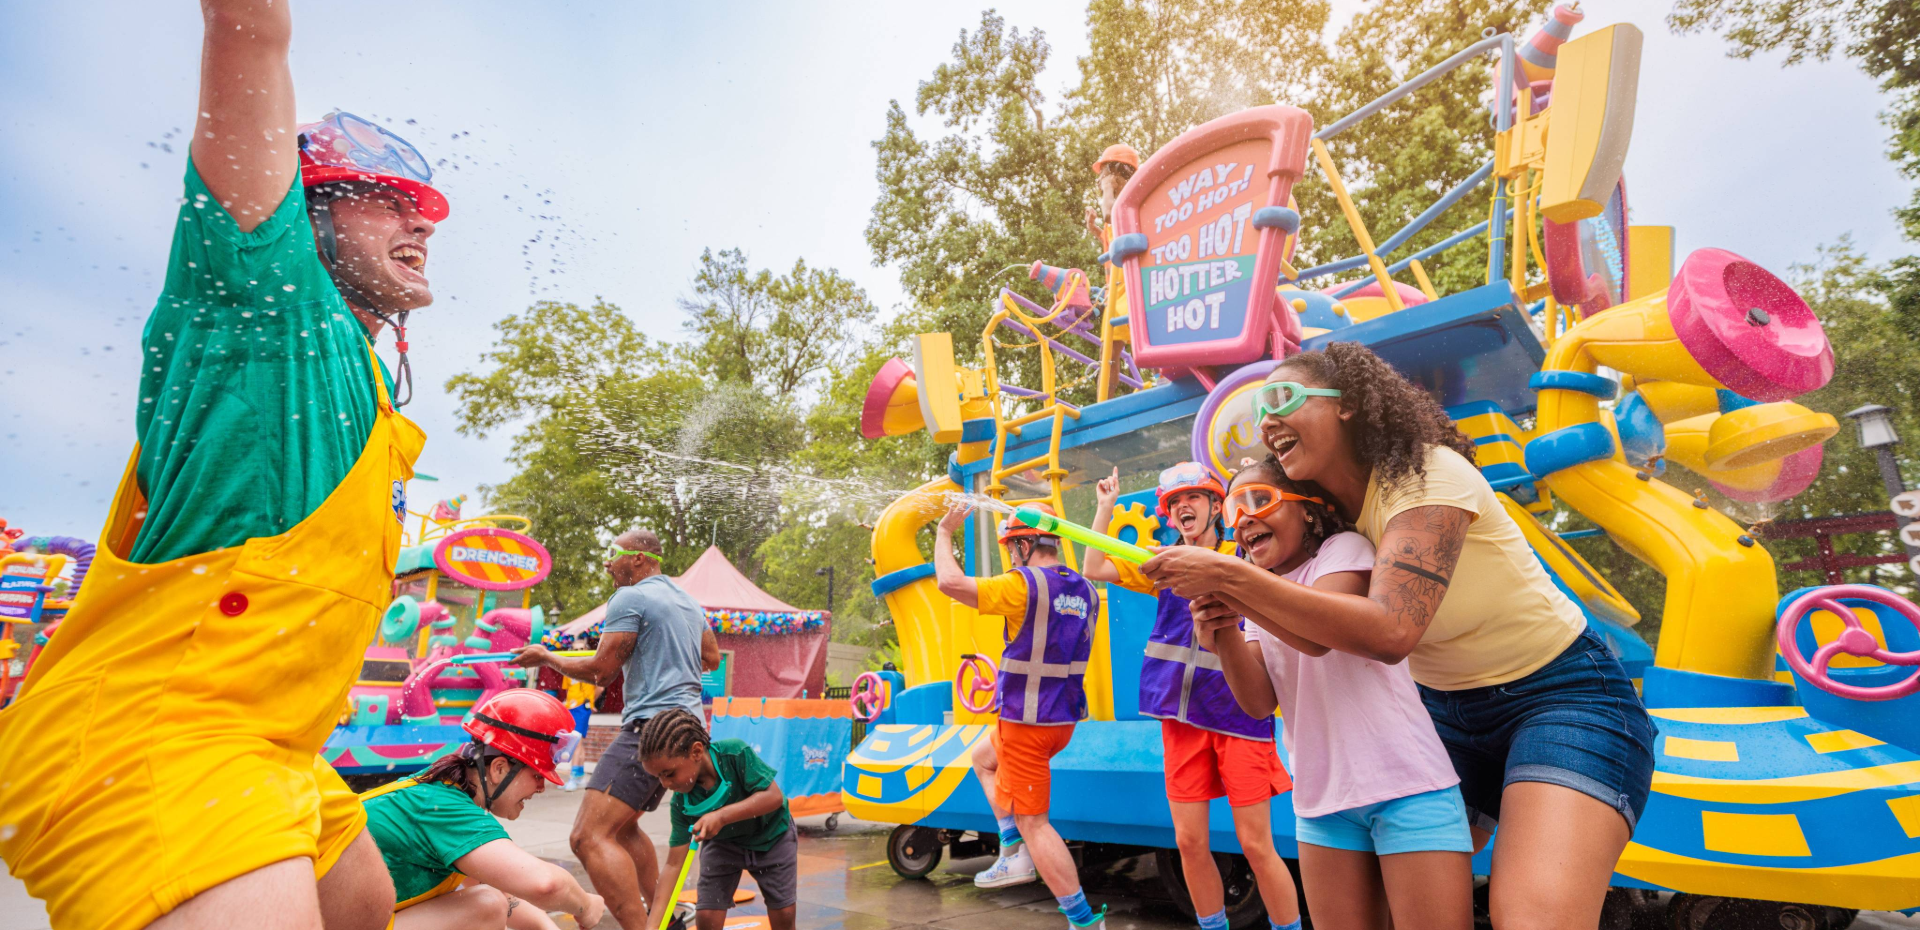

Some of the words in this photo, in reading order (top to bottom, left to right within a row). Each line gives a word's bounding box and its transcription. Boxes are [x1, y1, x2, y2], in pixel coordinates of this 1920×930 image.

[1154, 201, 1194, 234] TOO
[1196, 164, 1255, 214] HOT!
[1167, 162, 1238, 207] WAY
[1150, 233, 1191, 265] TOO
[1198, 201, 1253, 259] HOT
[1149, 259, 1243, 307] HOTTER
[1167, 290, 1226, 333] HOT
[451, 545, 539, 572] DRENCHER
